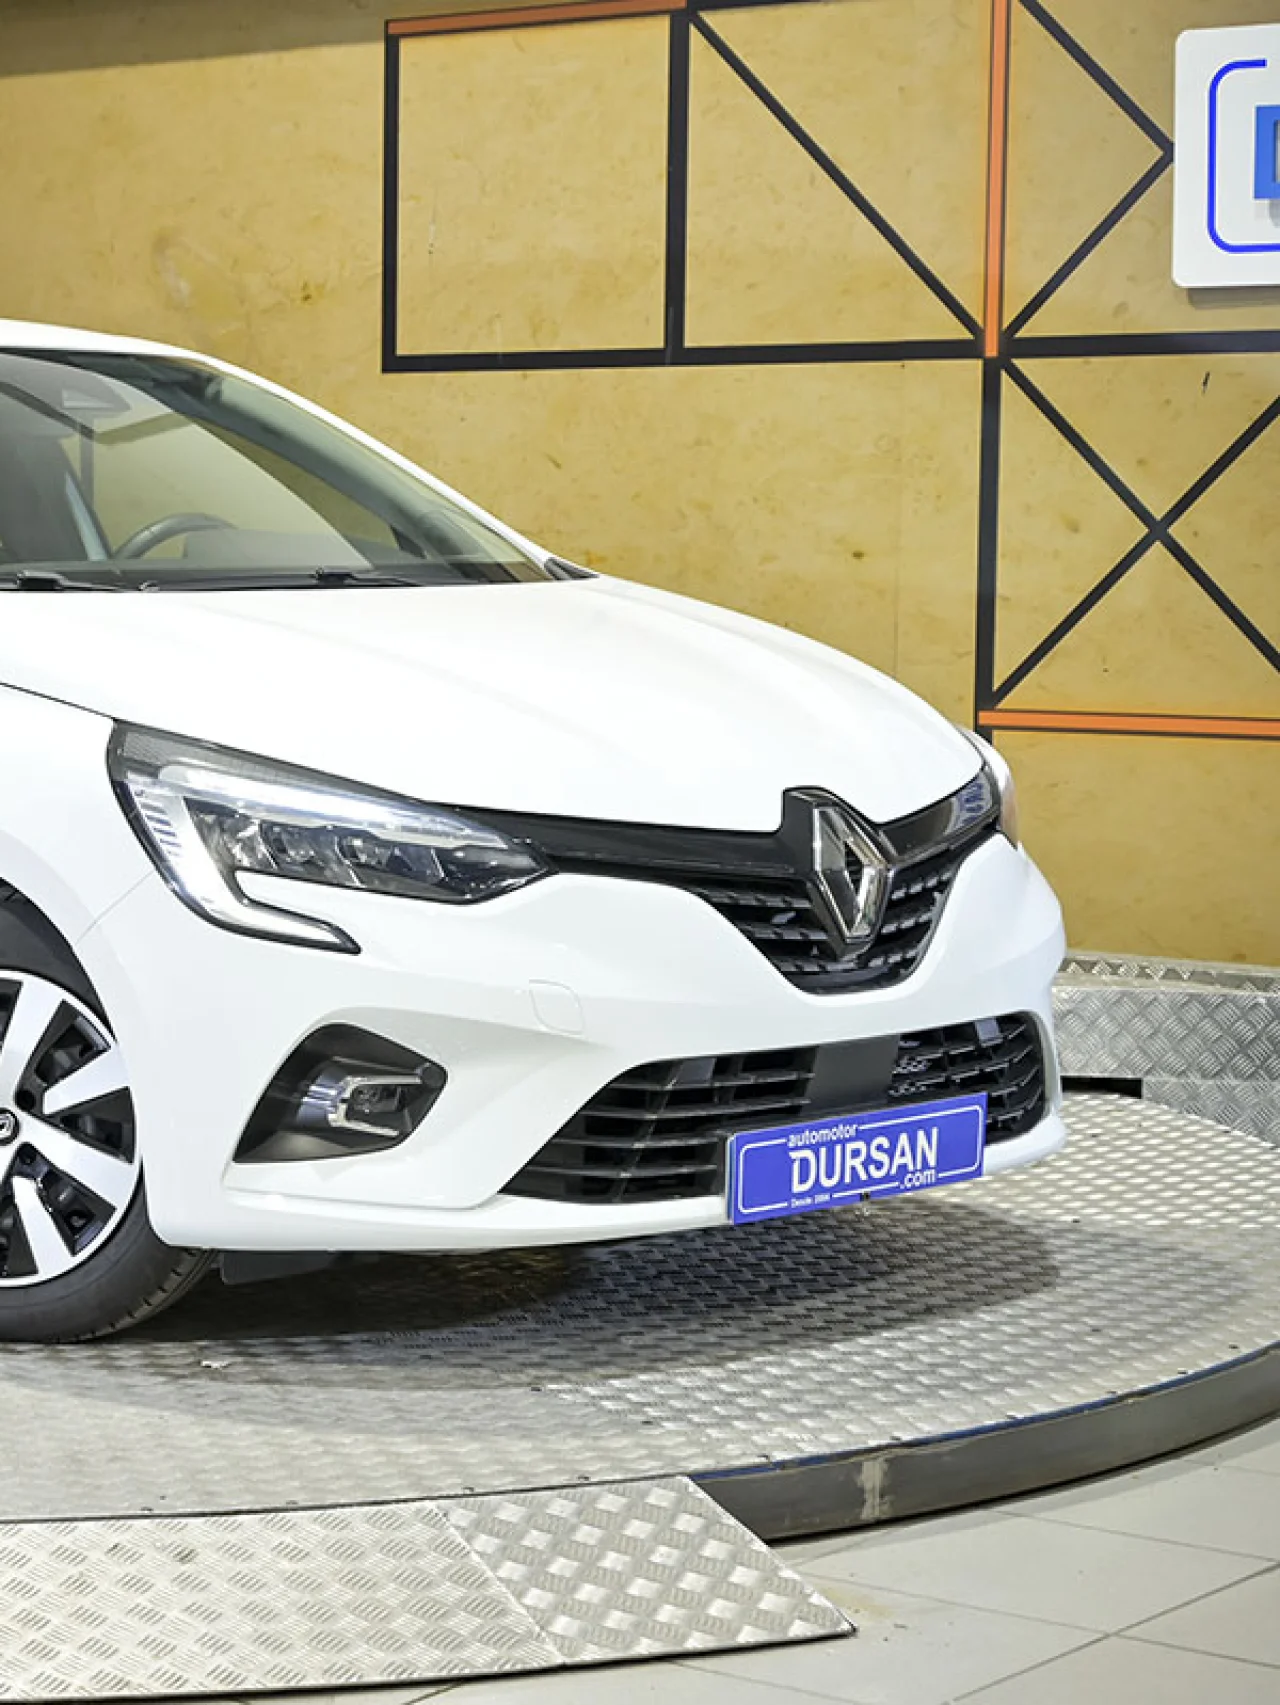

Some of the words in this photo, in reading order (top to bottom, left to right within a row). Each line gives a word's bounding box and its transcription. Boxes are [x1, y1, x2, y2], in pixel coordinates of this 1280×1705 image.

[787, 1124, 858, 1148] automotor
[789, 1127, 938, 1193] DURSAN
[900, 1169, 936, 1189] .com
